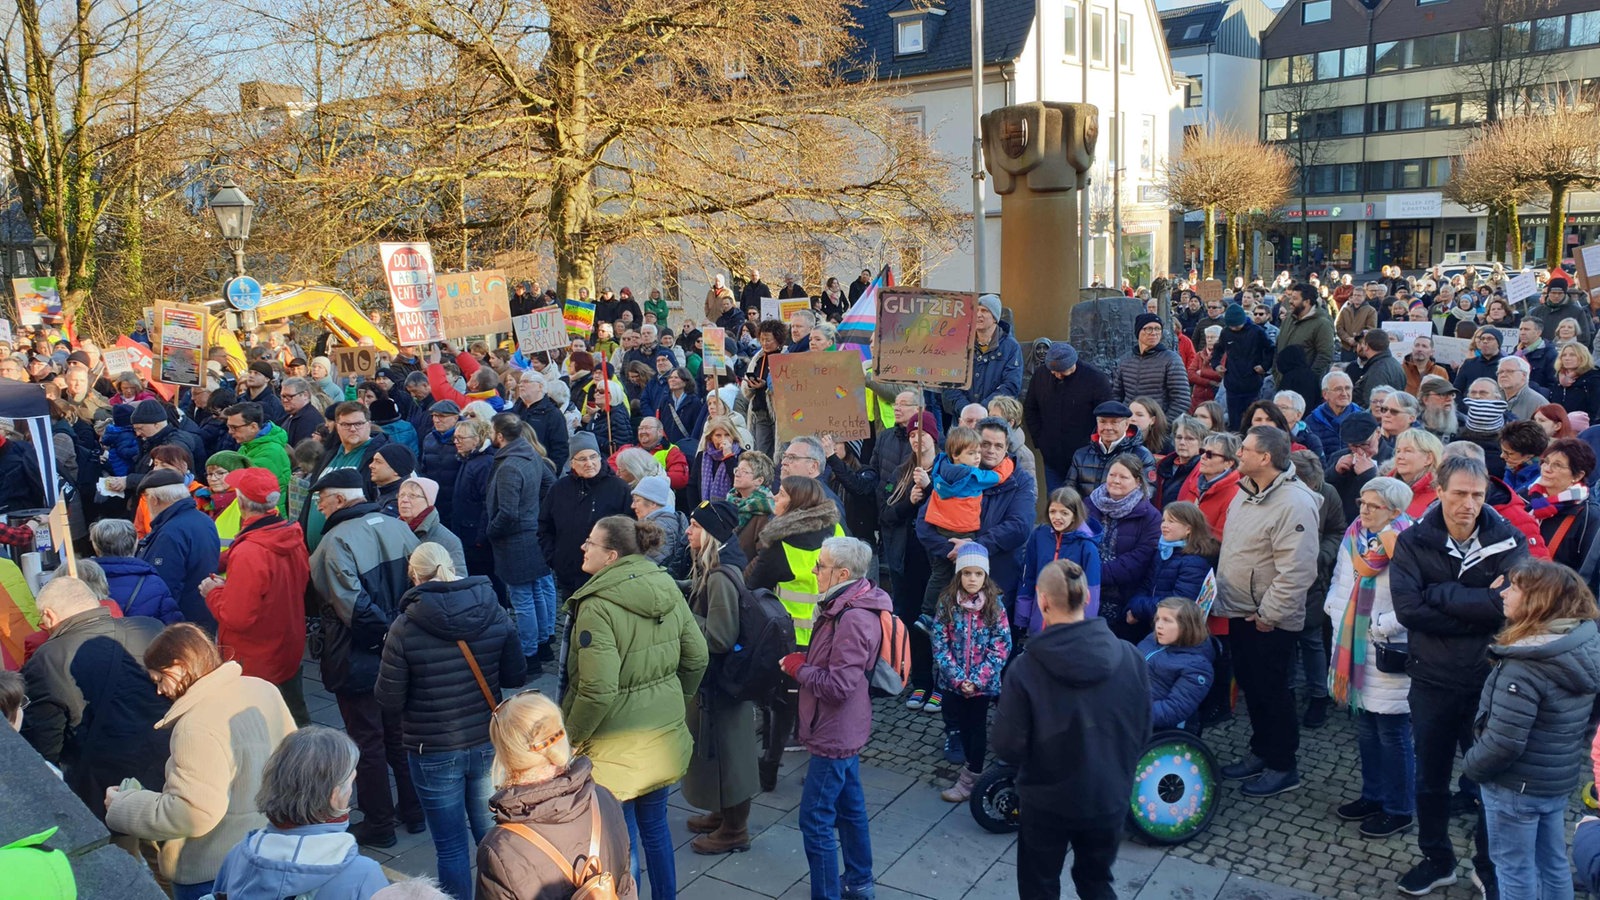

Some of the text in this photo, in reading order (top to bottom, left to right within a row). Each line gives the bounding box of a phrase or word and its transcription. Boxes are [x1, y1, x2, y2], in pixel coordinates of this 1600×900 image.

[393, 253, 423, 268] DO NOT
[397, 285, 429, 301] ENTER
[884, 296, 966, 318] GLITZER
[397, 311, 436, 327] WRONG
[519, 311, 560, 332] BUNT
[406, 324, 432, 340] WAY
[917, 319, 957, 337] Alle
[521, 331, 568, 352] BRAUN
[340, 350, 371, 372] NO
[828, 415, 866, 428] Rechte
